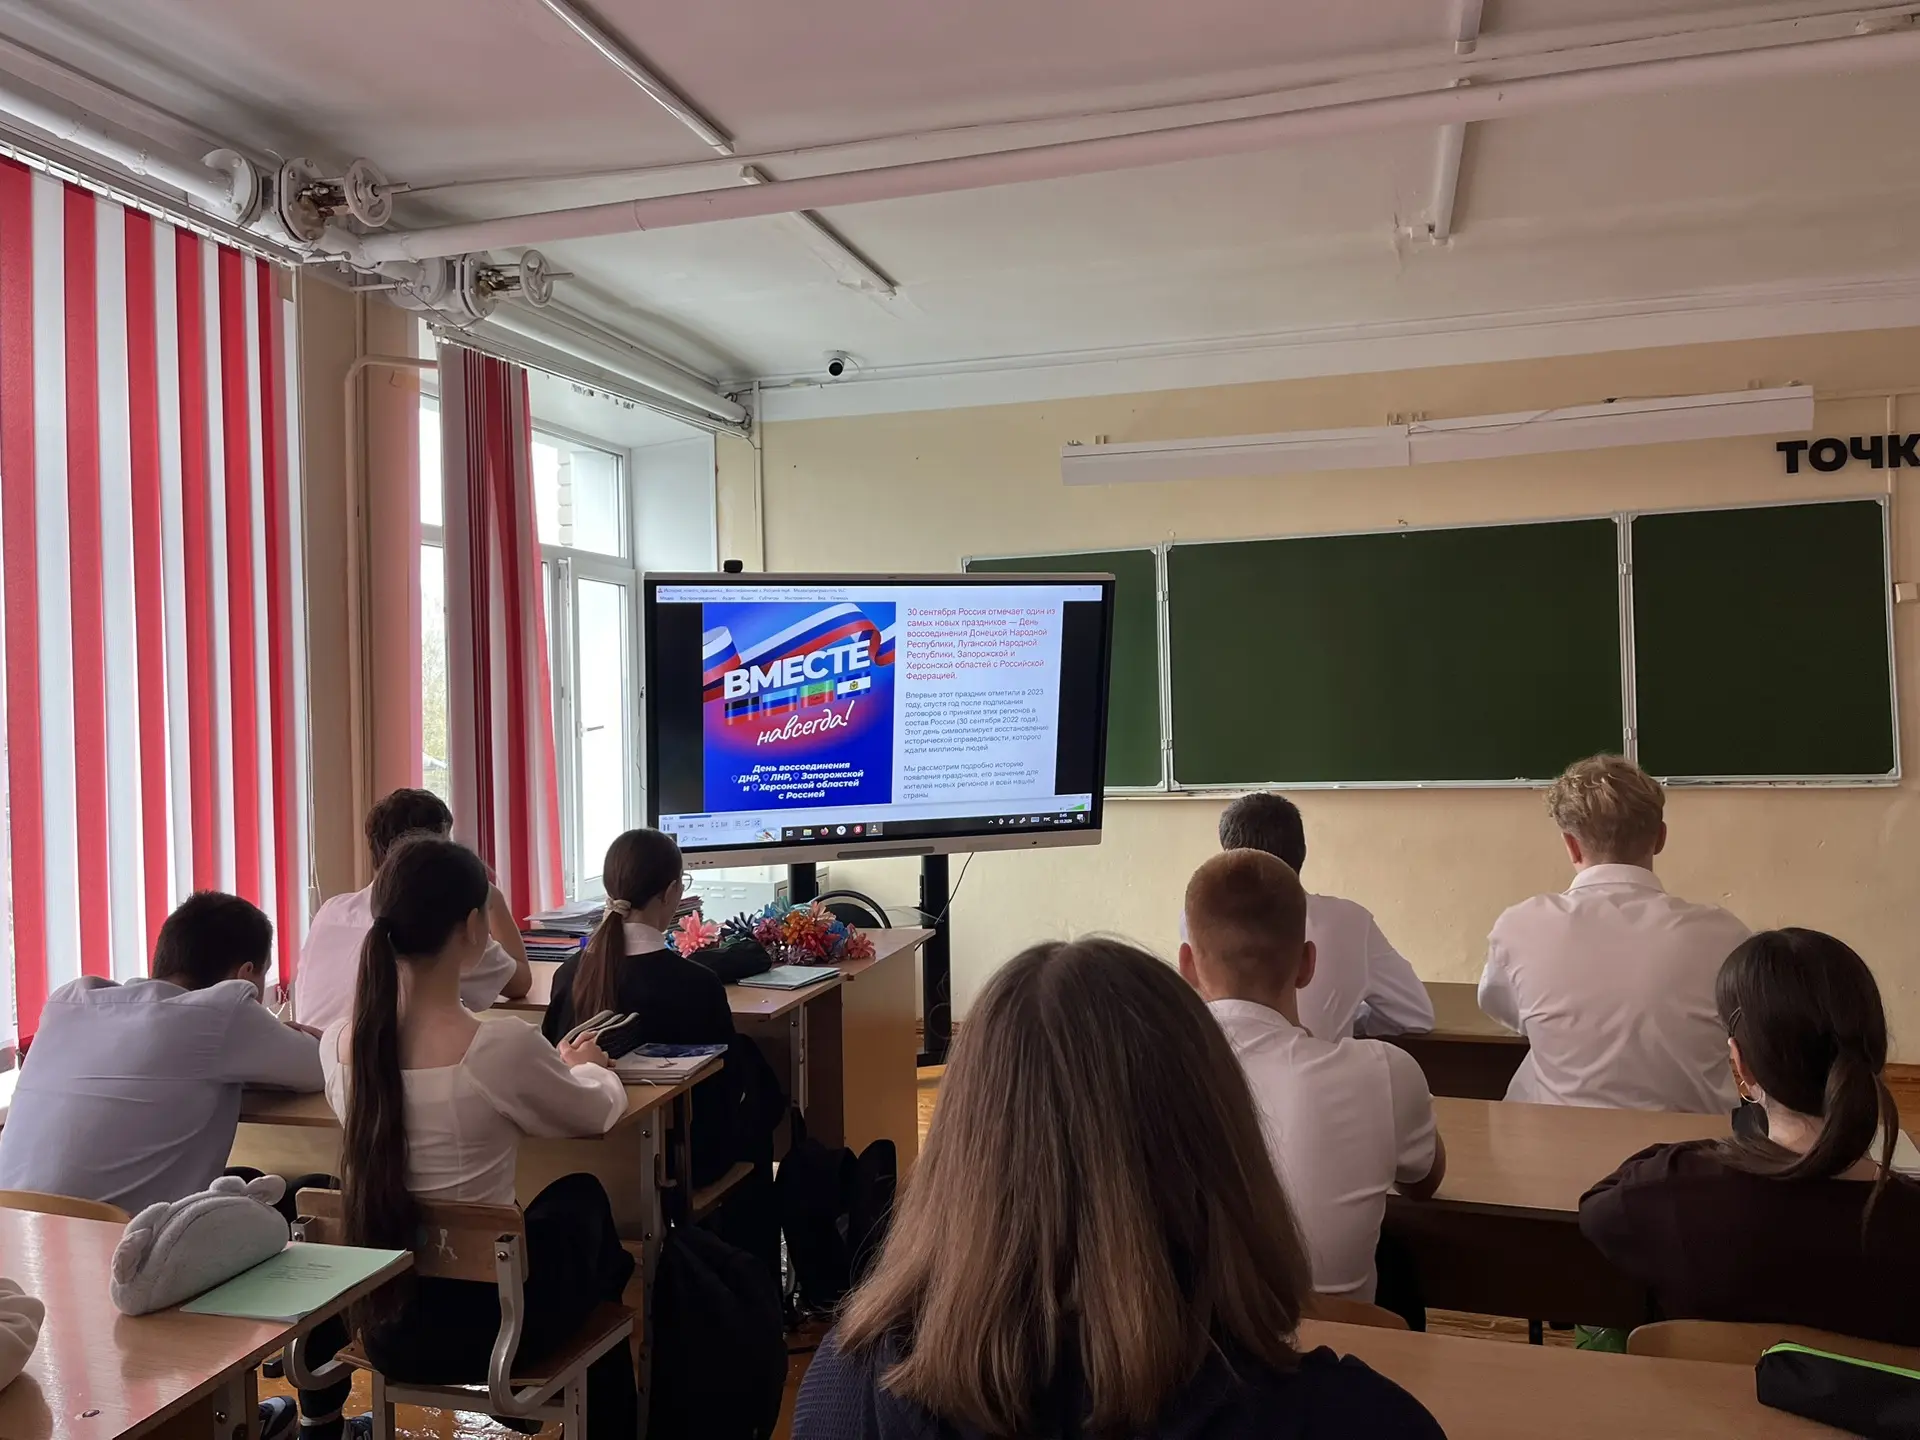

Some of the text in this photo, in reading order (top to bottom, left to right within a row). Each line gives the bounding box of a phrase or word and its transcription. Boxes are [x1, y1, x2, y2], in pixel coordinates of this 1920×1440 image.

[1776, 433, 1920, 473] ТОЧК
[907, 608, 917, 616] 30
[919, 608, 956, 617] сентября
[1019, 618, 1038, 626] День
[969, 629, 1007, 637] Донецкой
[907, 639, 1037, 649] Республики, Луганской Народной
[957, 650, 1008, 659] Запорожской
[724, 640, 871, 699] ВМЕСТЕ
[906, 661, 953, 670] Херсонской
[906, 672, 957, 681] Федерацией.
[757, 700, 855, 746] навсегда!
[969, 717, 1001, 725] сентября
[904, 736, 952, 745] исторической
[752, 762, 850, 773] День воссоединения
[917, 764, 959, 772] рассмотрим
[961, 762, 993, 770] подробно
[738, 770, 864, 783] ДНР, ЛНР, Запорожской
[903, 773, 941, 781] появления
[759, 781, 814, 791] Херсонской
[816, 780, 859, 788] областей
[957, 780, 988, 788] регионов
[786, 790, 825, 799] Россией
